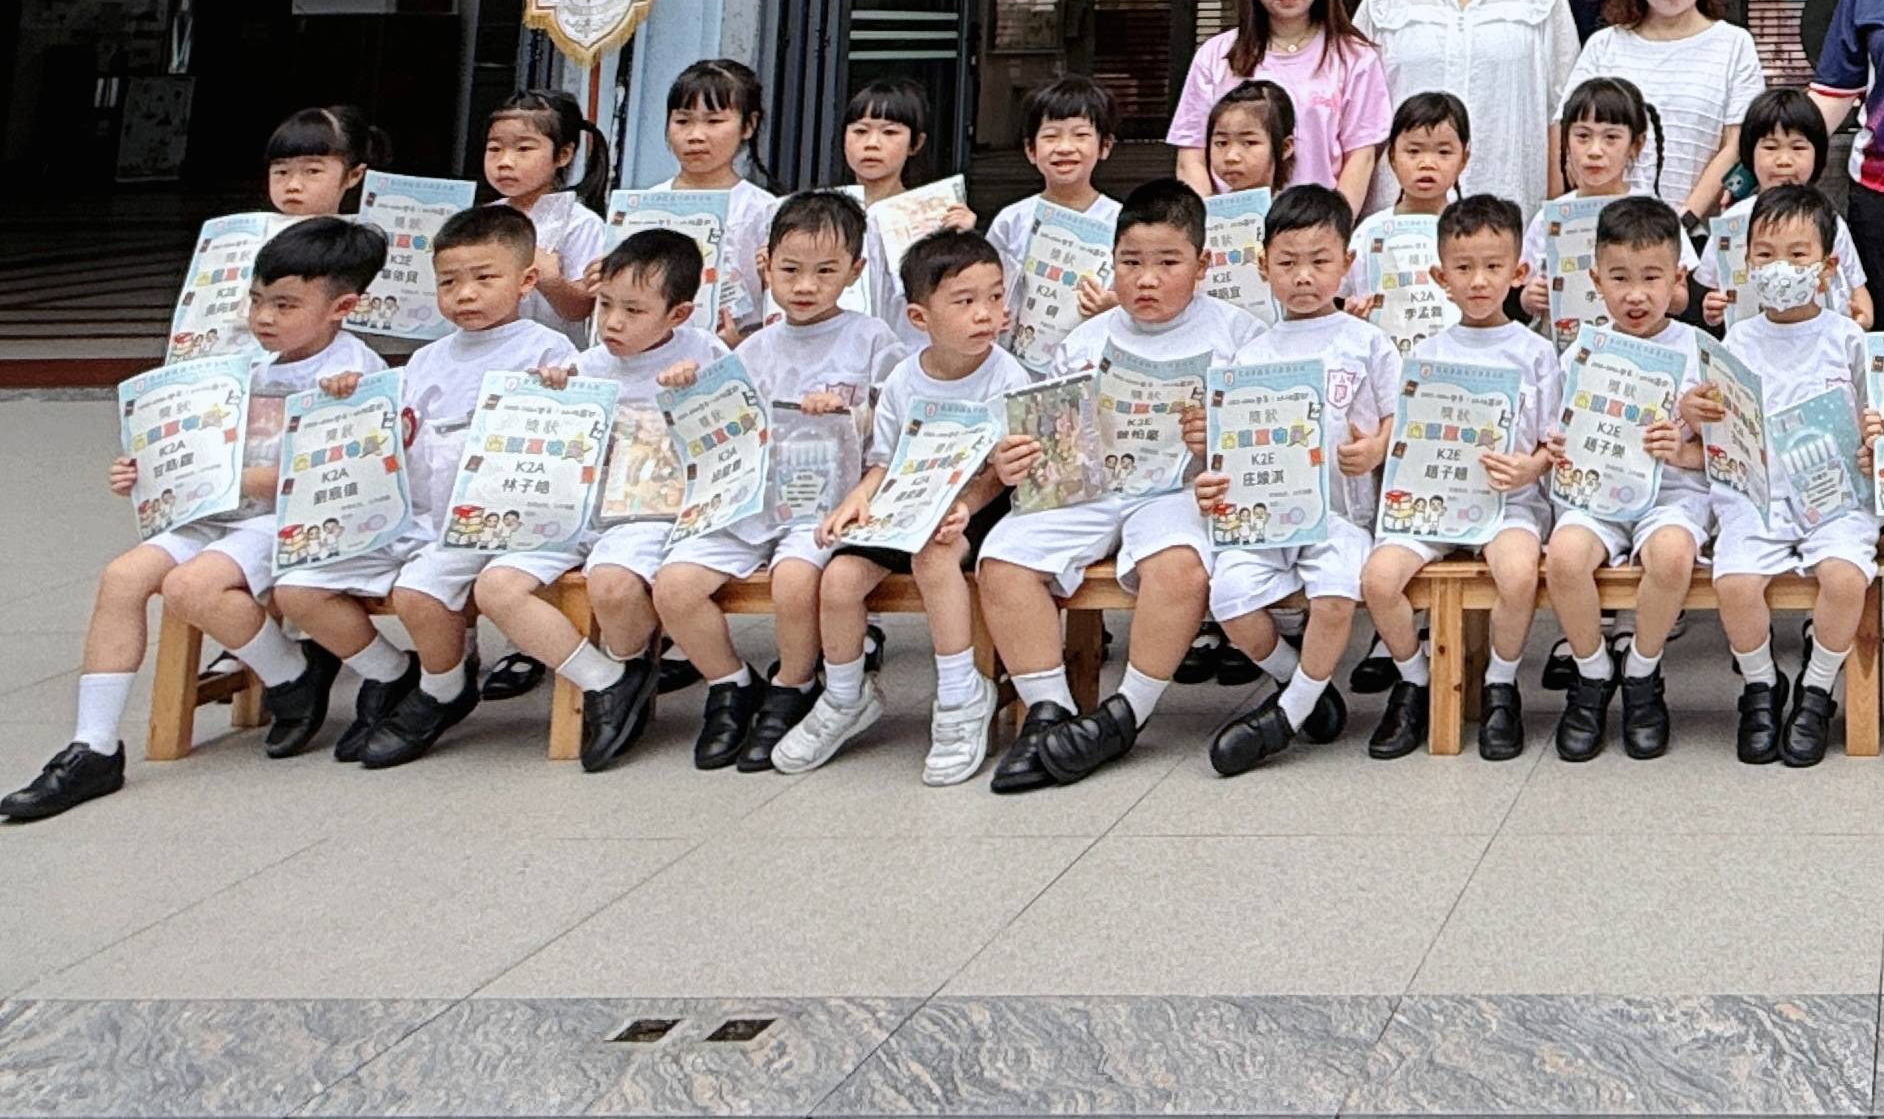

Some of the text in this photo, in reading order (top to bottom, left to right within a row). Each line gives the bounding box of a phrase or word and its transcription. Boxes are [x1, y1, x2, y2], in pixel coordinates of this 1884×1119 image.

[1410, 290, 1435, 303] K2A
[1597, 421, 1623, 438] K2E
[158, 440, 186, 458] K2A
[1251, 452, 1276, 466] K2E
[321, 467, 350, 483] K2A
[515, 461, 546, 475] K2A
